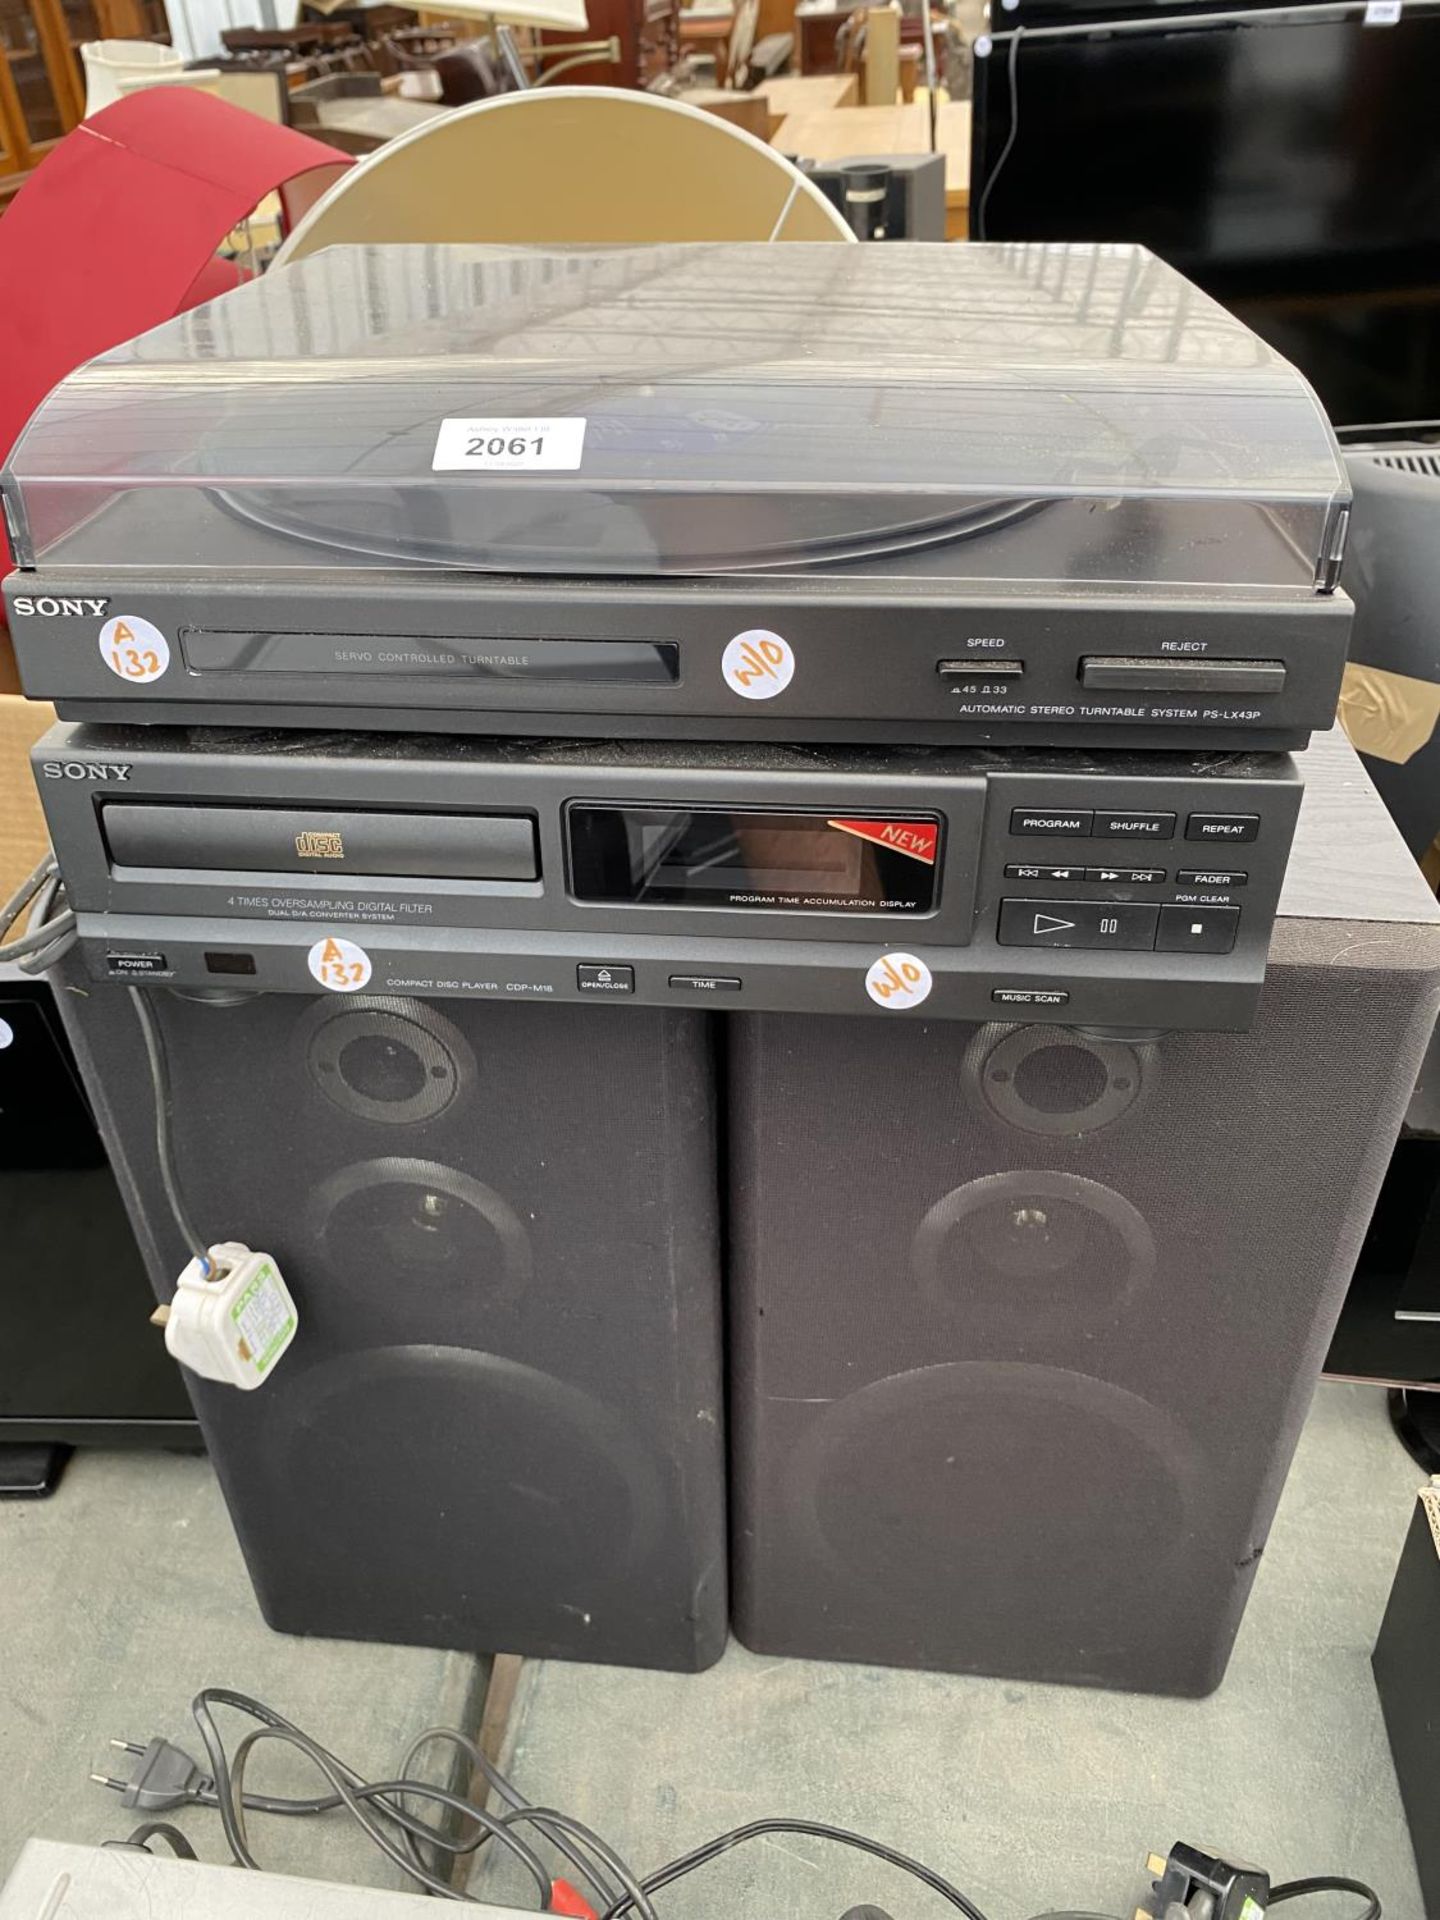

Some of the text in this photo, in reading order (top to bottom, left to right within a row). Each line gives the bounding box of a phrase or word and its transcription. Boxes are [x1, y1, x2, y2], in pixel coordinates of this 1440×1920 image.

[465, 437, 544, 456] 2061
[13, 597, 108, 616] SONY
[113, 621, 135, 645] A
[966, 638, 1005, 648] SPEED
[1161, 641, 1208, 651] REJECT
[112, 650, 161, 677] 132
[334, 651, 529, 665] SERVO CONTROLLED TURNTABLE
[962, 685, 1008, 694] 45 33
[959, 704, 1261, 719] AUTOMATIC STEREO TURNTABLE SYSTEM PS-LX43P
[43, 762, 131, 781] SONY
[1023, 819, 1080, 828] PROGRAM
[1110, 822, 1160, 831] SHUFFLE
[1202, 824, 1244, 834] REPEAT
[880, 824, 934, 854] NEW
[1194, 875, 1231, 884] FADER
[729, 894, 917, 909] PROGRAM TIME ACCUMULATION DISPLAY
[1175, 894, 1197, 902] PGM
[227, 896, 433, 914] 4 TIMES OVERSAMPLING DIGITAL FILTER
[310, 911, 360, 919] CONVERTER
[322, 935, 343, 963] A
[118, 960, 153, 968] POWER
[321, 962, 364, 985] 132
[386, 978, 433, 988] COMPACT
[436, 980, 459, 988] DISC
[462, 982, 498, 990] PLAYER
[581, 981, 629, 990] OPEN/CLOSE
[692, 981, 717, 989] TIME
[1001, 994, 1061, 1003] MUSIC SCAN
